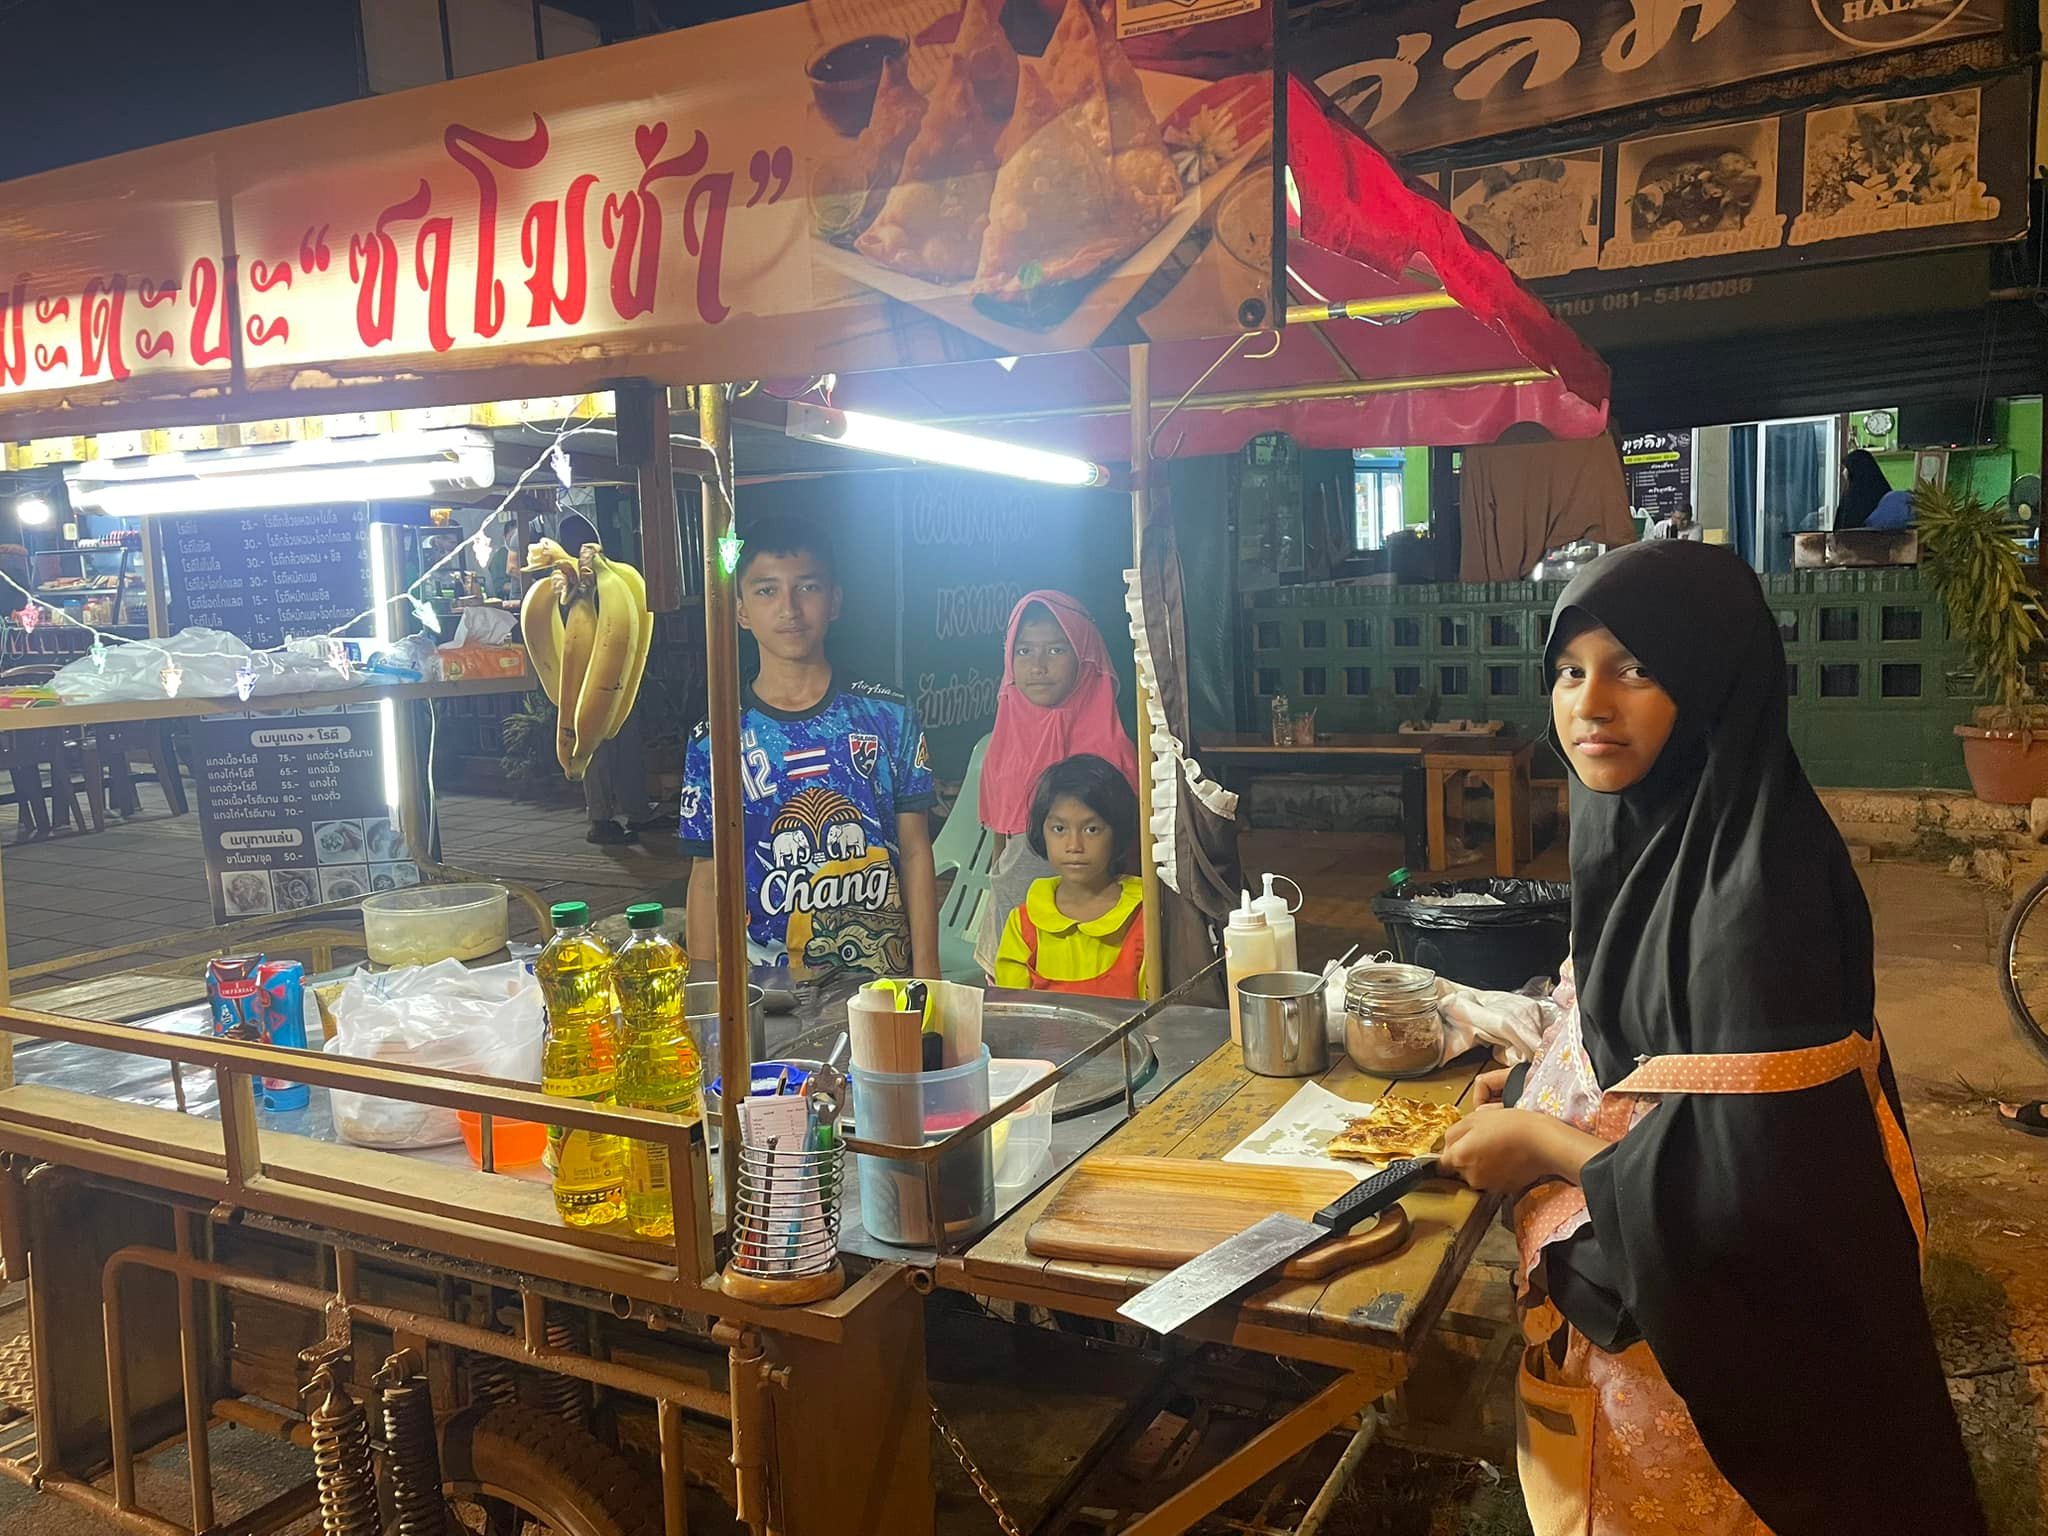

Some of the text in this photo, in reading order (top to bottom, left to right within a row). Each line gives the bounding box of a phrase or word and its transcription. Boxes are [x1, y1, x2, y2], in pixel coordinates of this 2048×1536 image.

[260, 731, 303, 746] เมนูแกง
[277, 754, 296, 763] 75.-
[280, 768, 298, 776] 65.-
[281, 781, 299, 789] 55.-
[285, 808, 304, 817] 70.-
[230, 831, 294, 848] เมนูทานเล่น
[284, 852, 303, 861] 50.-
[760, 867, 890, 916] Chang
